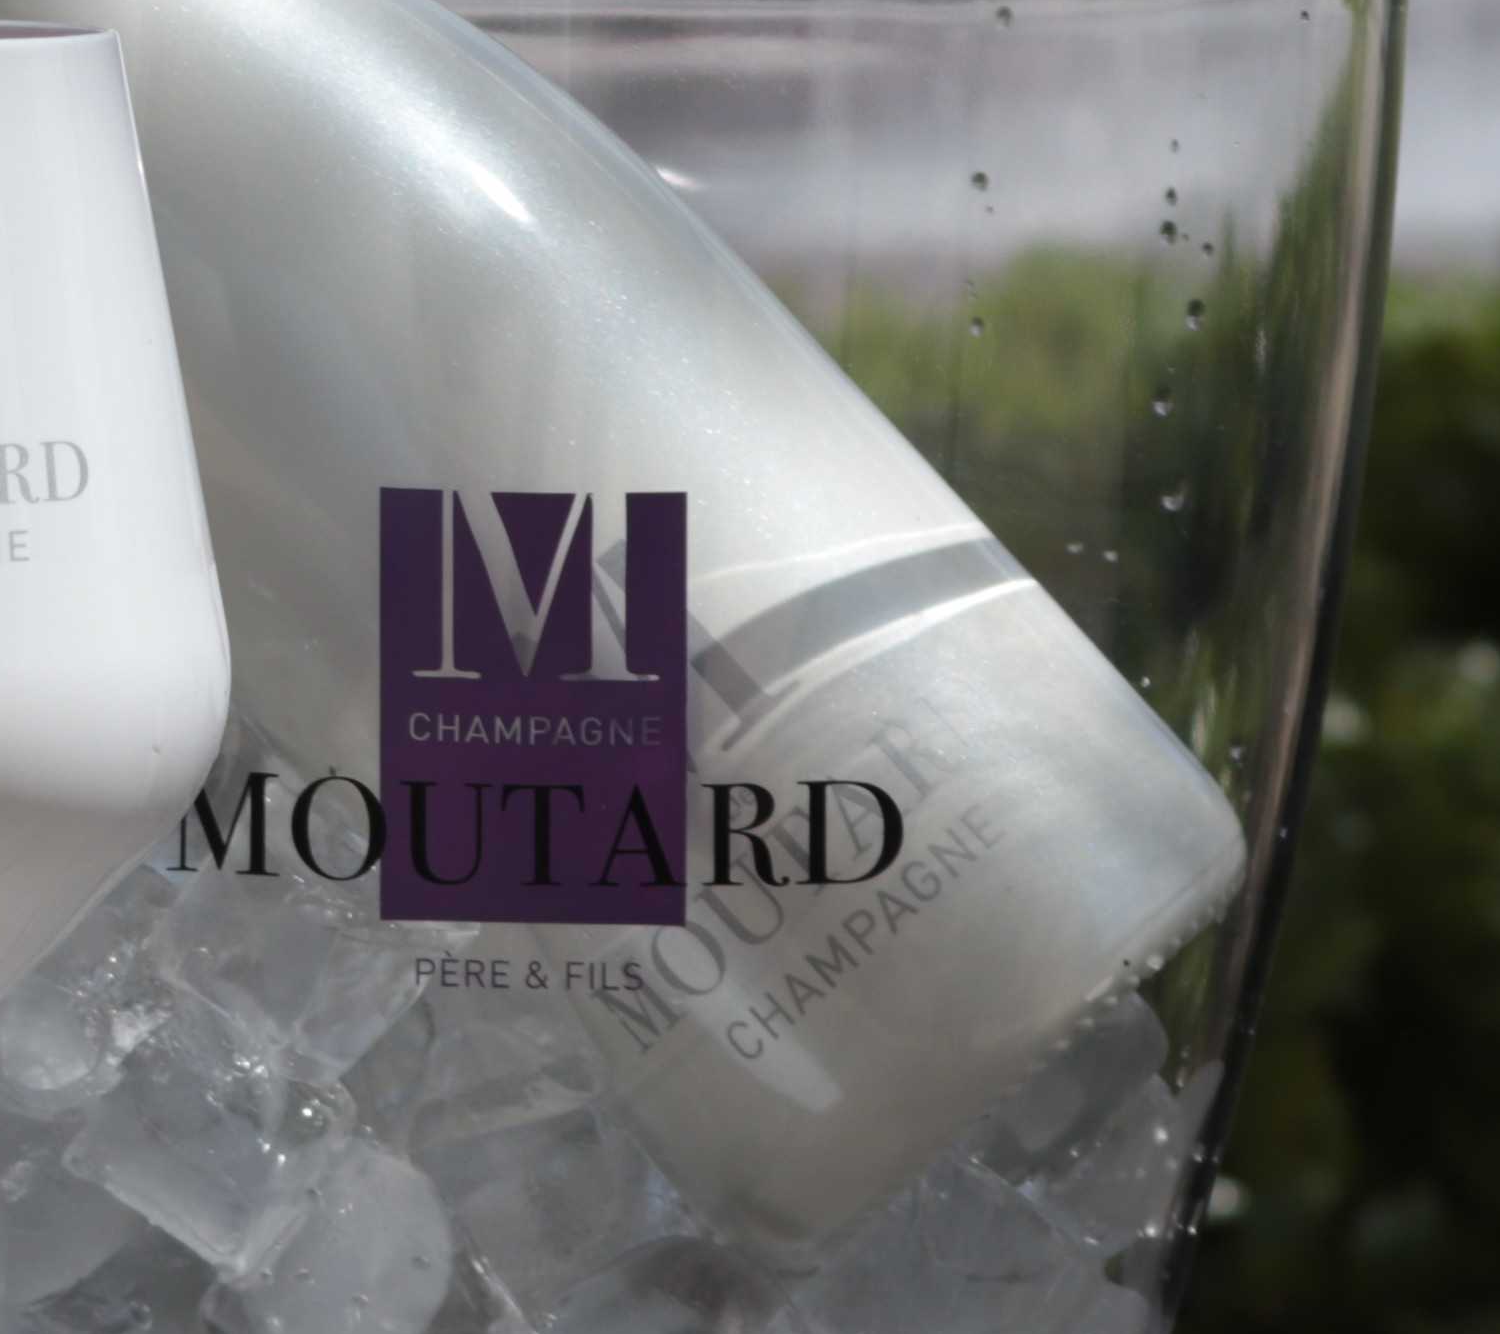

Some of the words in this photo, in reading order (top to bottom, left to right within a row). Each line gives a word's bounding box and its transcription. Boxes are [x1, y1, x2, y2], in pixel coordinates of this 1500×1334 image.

[411, 487, 661, 681] M
[408, 712, 663, 746] CHAMPAGNE
[165, 771, 905, 887] MOUTARD
[415, 950, 510, 989] PÈRE
[525, 960, 549, 990] &
[566, 961, 645, 992] FILS
[726, 804, 1007, 1060] CHAMPAGNE
